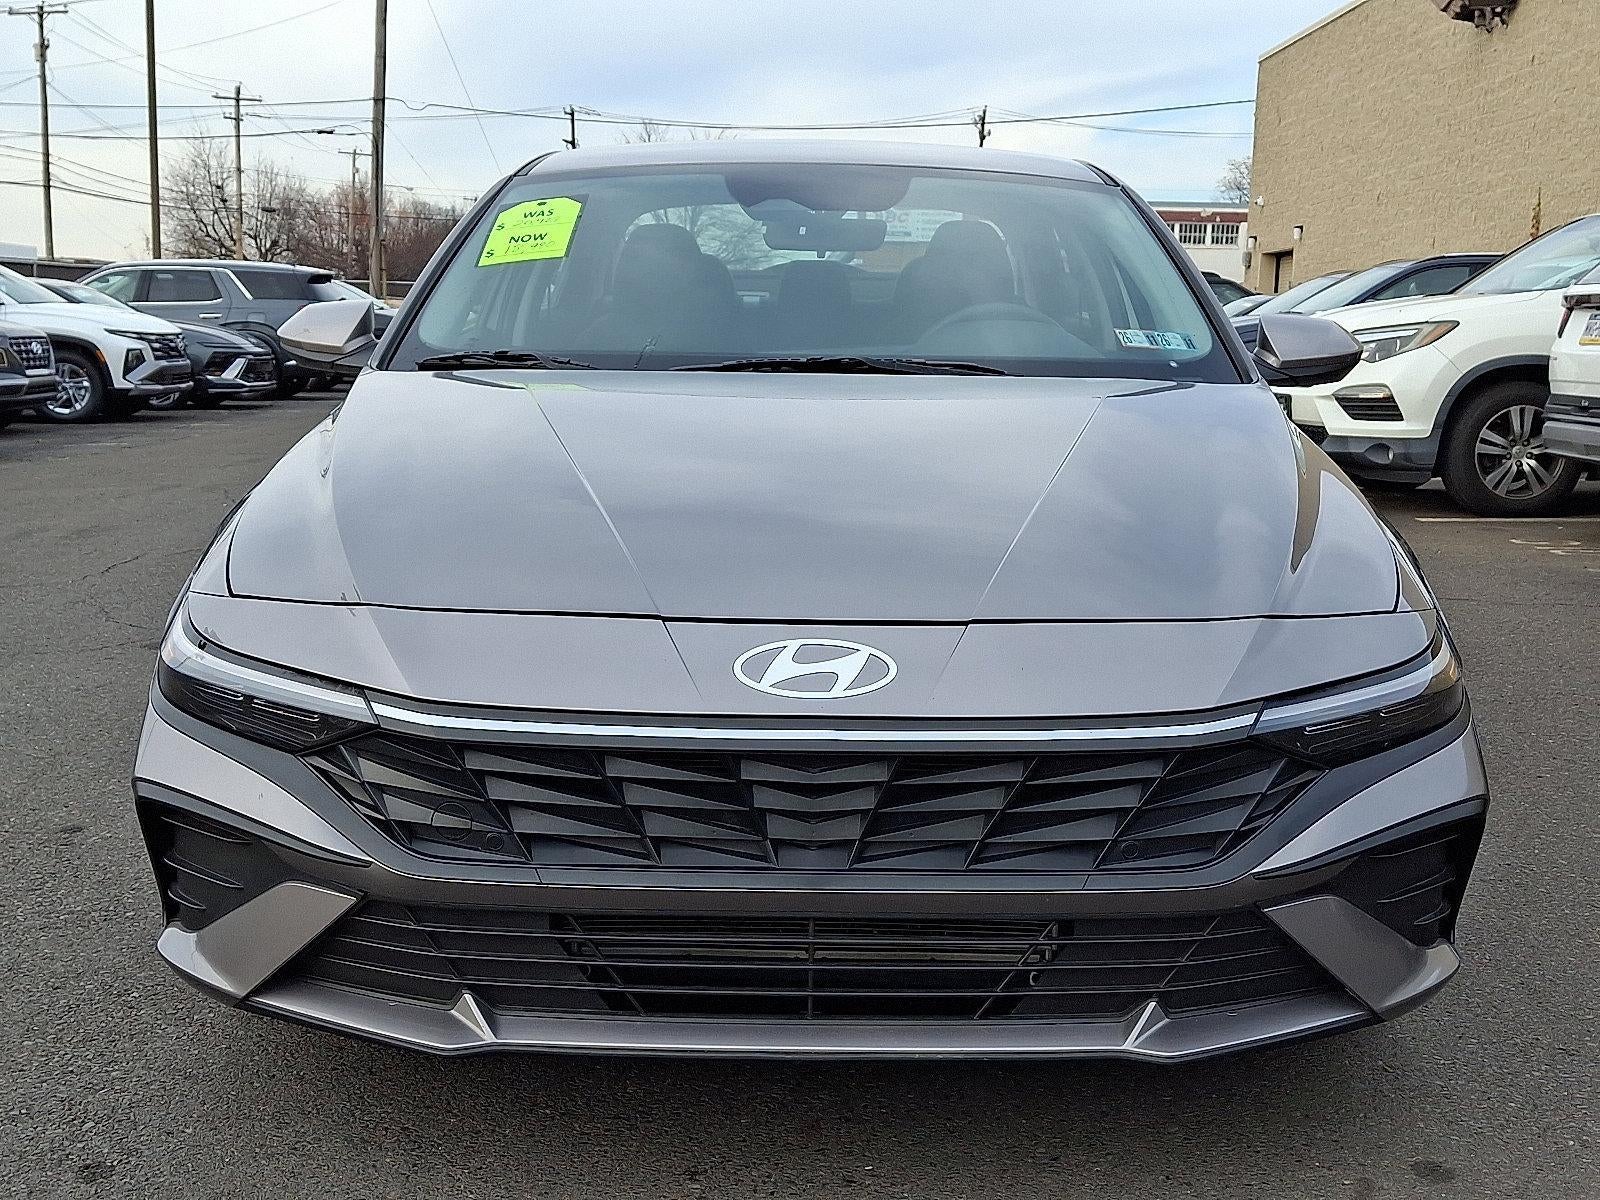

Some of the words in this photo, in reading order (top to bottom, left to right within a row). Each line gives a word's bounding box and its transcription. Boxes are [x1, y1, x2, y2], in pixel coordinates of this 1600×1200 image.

[524, 209, 554, 218] WAS
[496, 223, 505, 231] $
[508, 232, 548, 244] NOW
[485, 249, 495, 258] $
[1118, 331, 1133, 344] 26
[1145, 334, 1159, 347] 11
[1156, 333, 1172, 347] 26
[1184, 337, 1196, 349] 11
